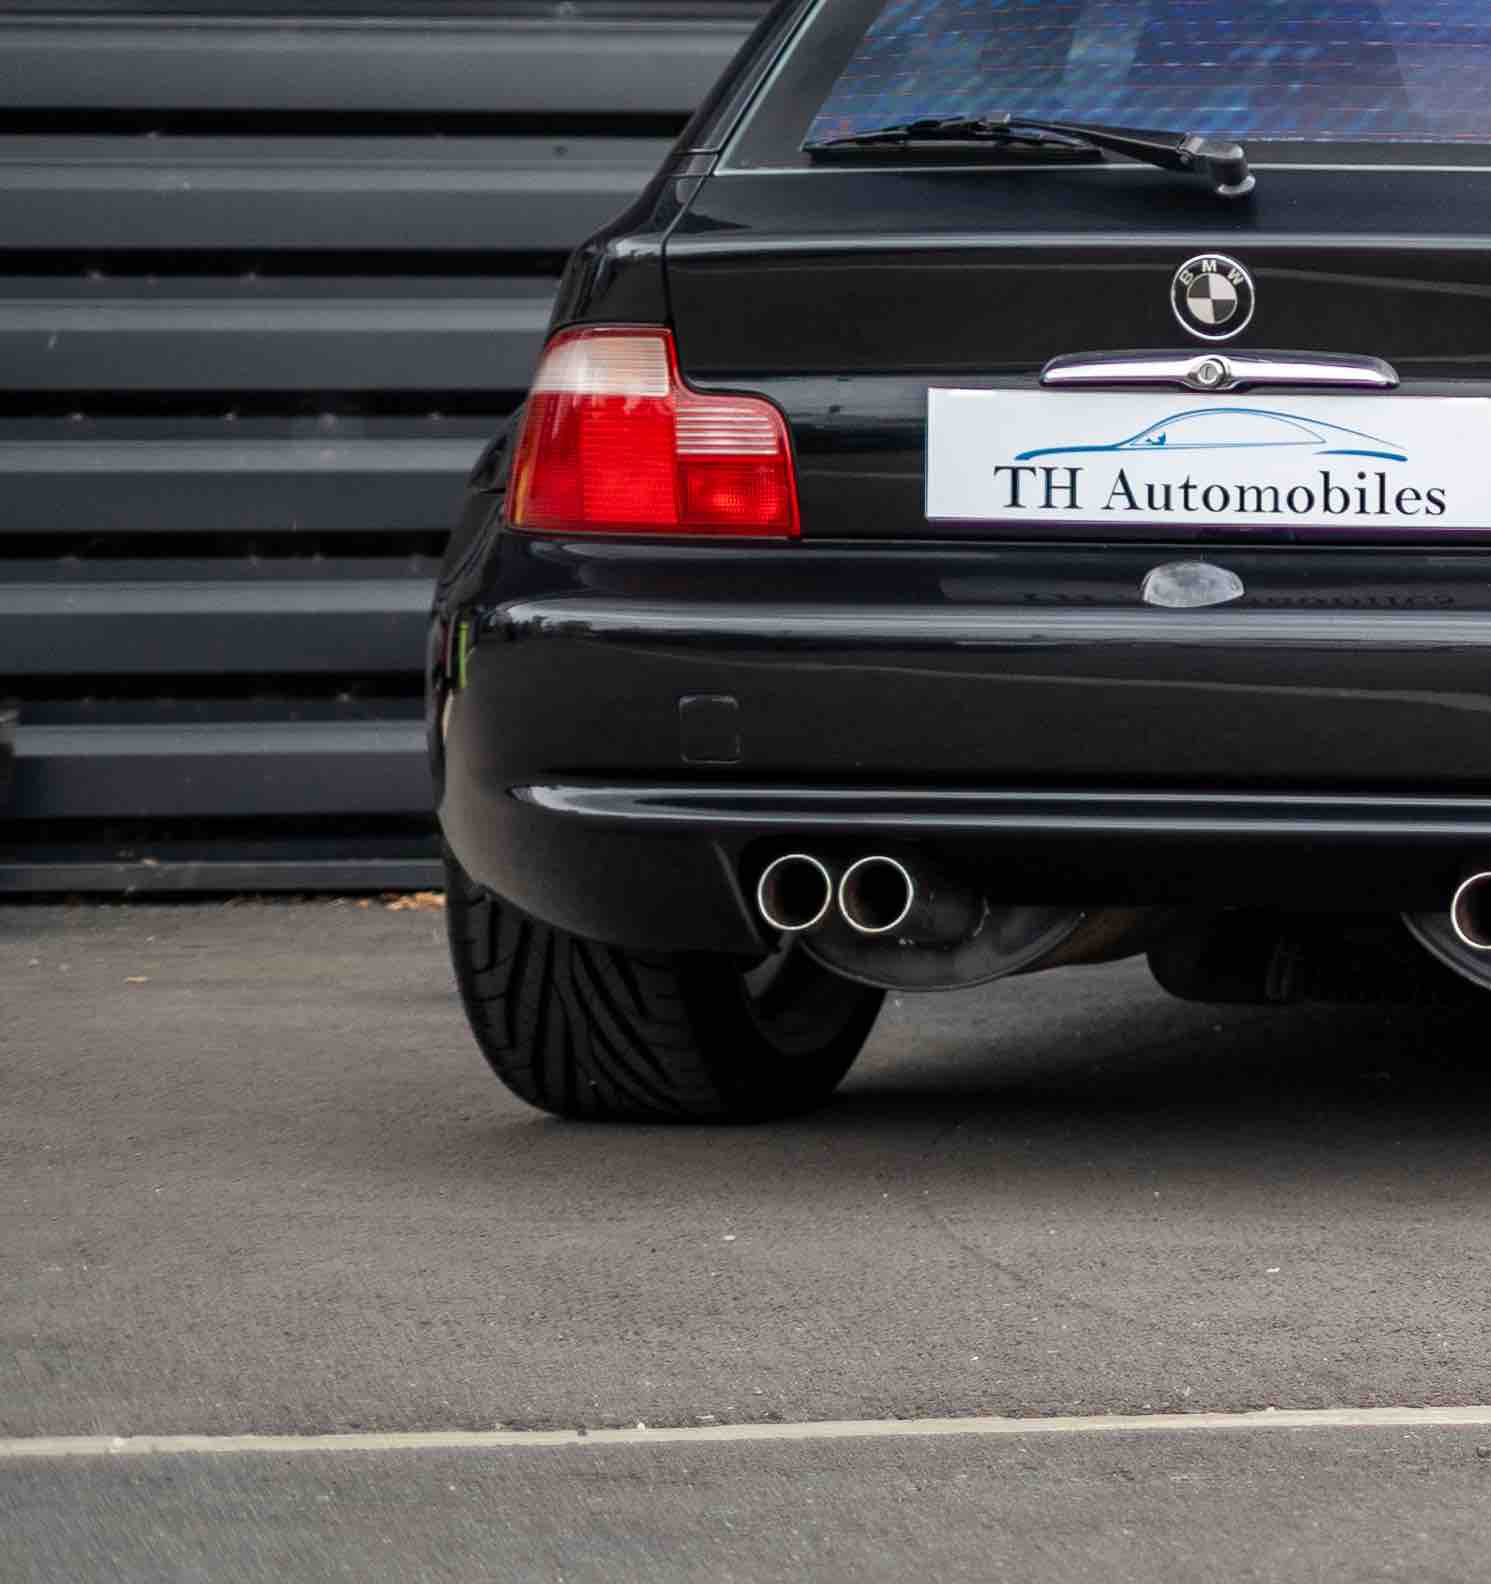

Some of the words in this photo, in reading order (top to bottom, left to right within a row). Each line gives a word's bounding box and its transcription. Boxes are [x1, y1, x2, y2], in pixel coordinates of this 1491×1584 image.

[1179, 259, 1244, 285] BMW
[993, 465, 1083, 511] TH
[1103, 468, 1446, 517] Automobiles
